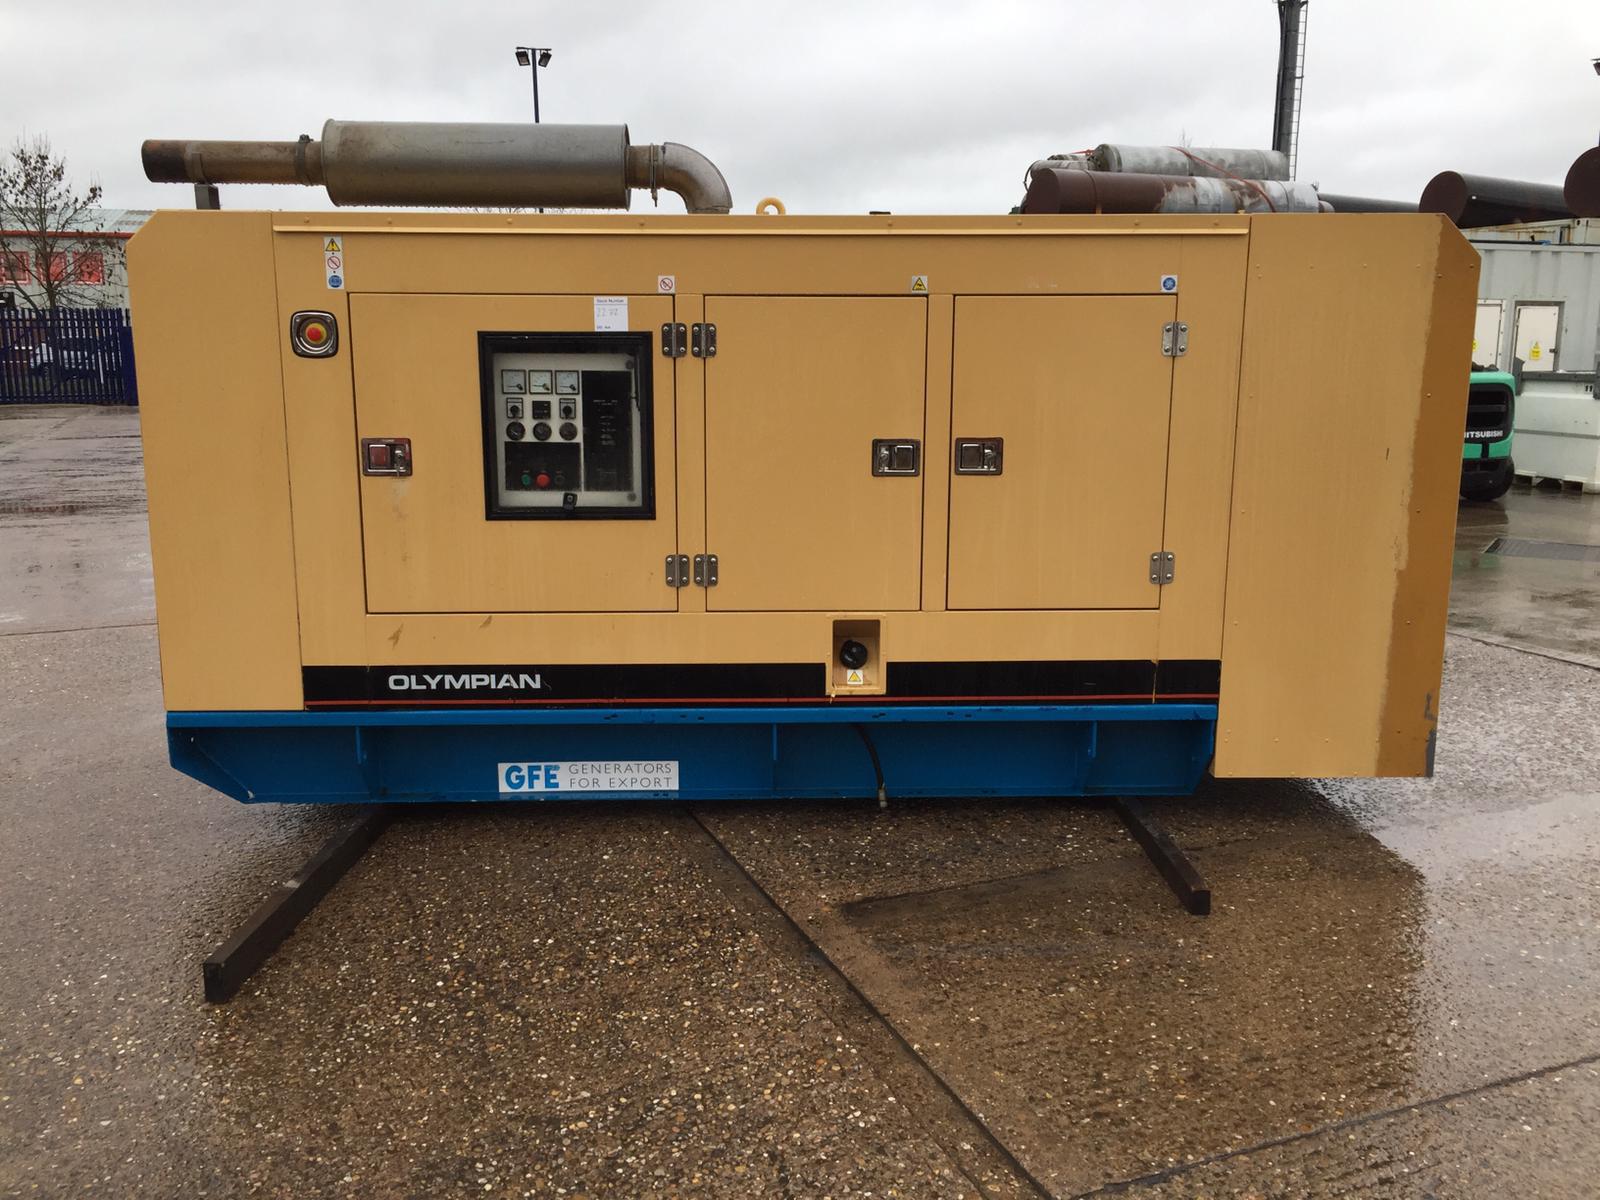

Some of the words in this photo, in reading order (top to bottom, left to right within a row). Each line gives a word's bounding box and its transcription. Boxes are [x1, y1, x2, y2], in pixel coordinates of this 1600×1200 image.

[388, 674, 541, 690] OLYMPIAN
[568, 763, 672, 775] GENERATORS
[505, 765, 560, 790] GFE
[570, 778, 600, 789] FOR
[609, 776, 673, 789] EXPORT
